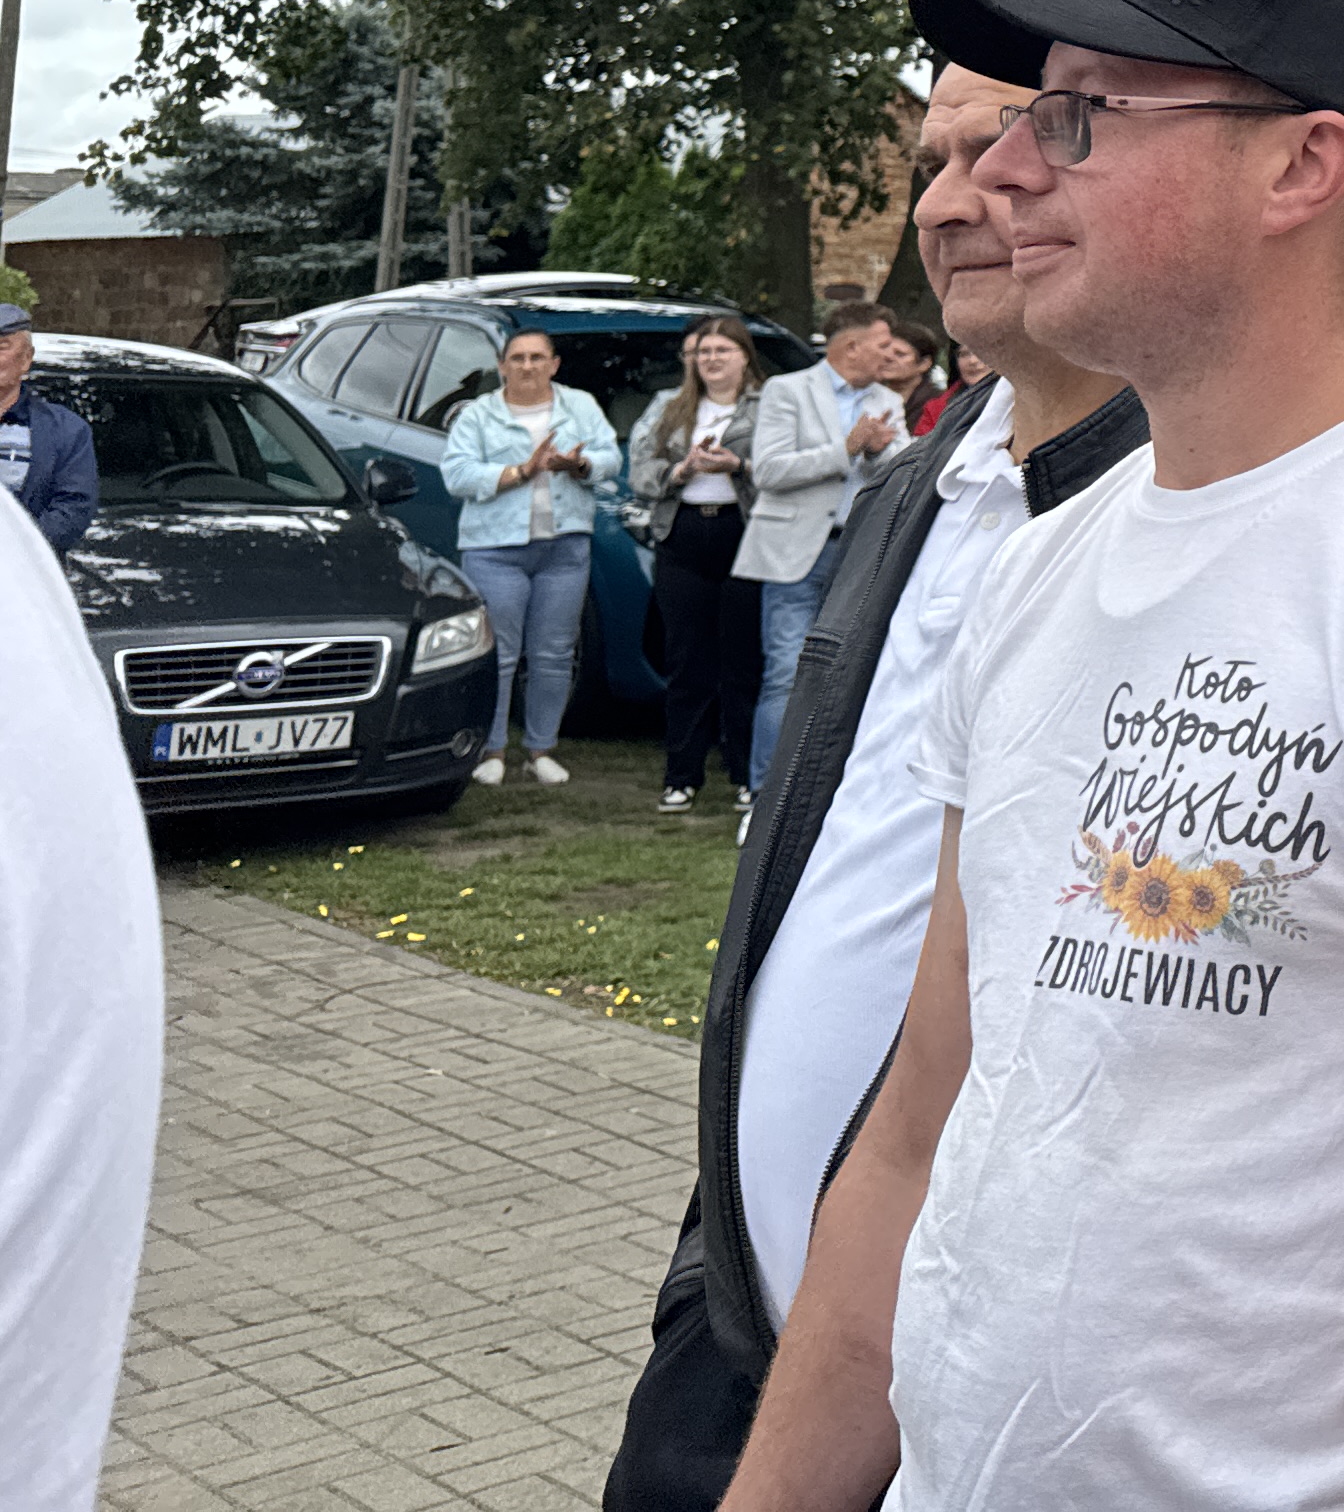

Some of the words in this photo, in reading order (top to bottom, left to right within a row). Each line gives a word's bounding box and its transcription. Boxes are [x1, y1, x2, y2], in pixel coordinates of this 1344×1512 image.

[1174, 652, 1267, 703] Koło
[177, 723, 249, 757] WML
[268, 716, 349, 751] JV77
[1103, 681, 1344, 798] Gospodyń
[1079, 757, 1331, 868] Wiejskich
[1034, 935, 1283, 1017] ZDROJEWIACY
